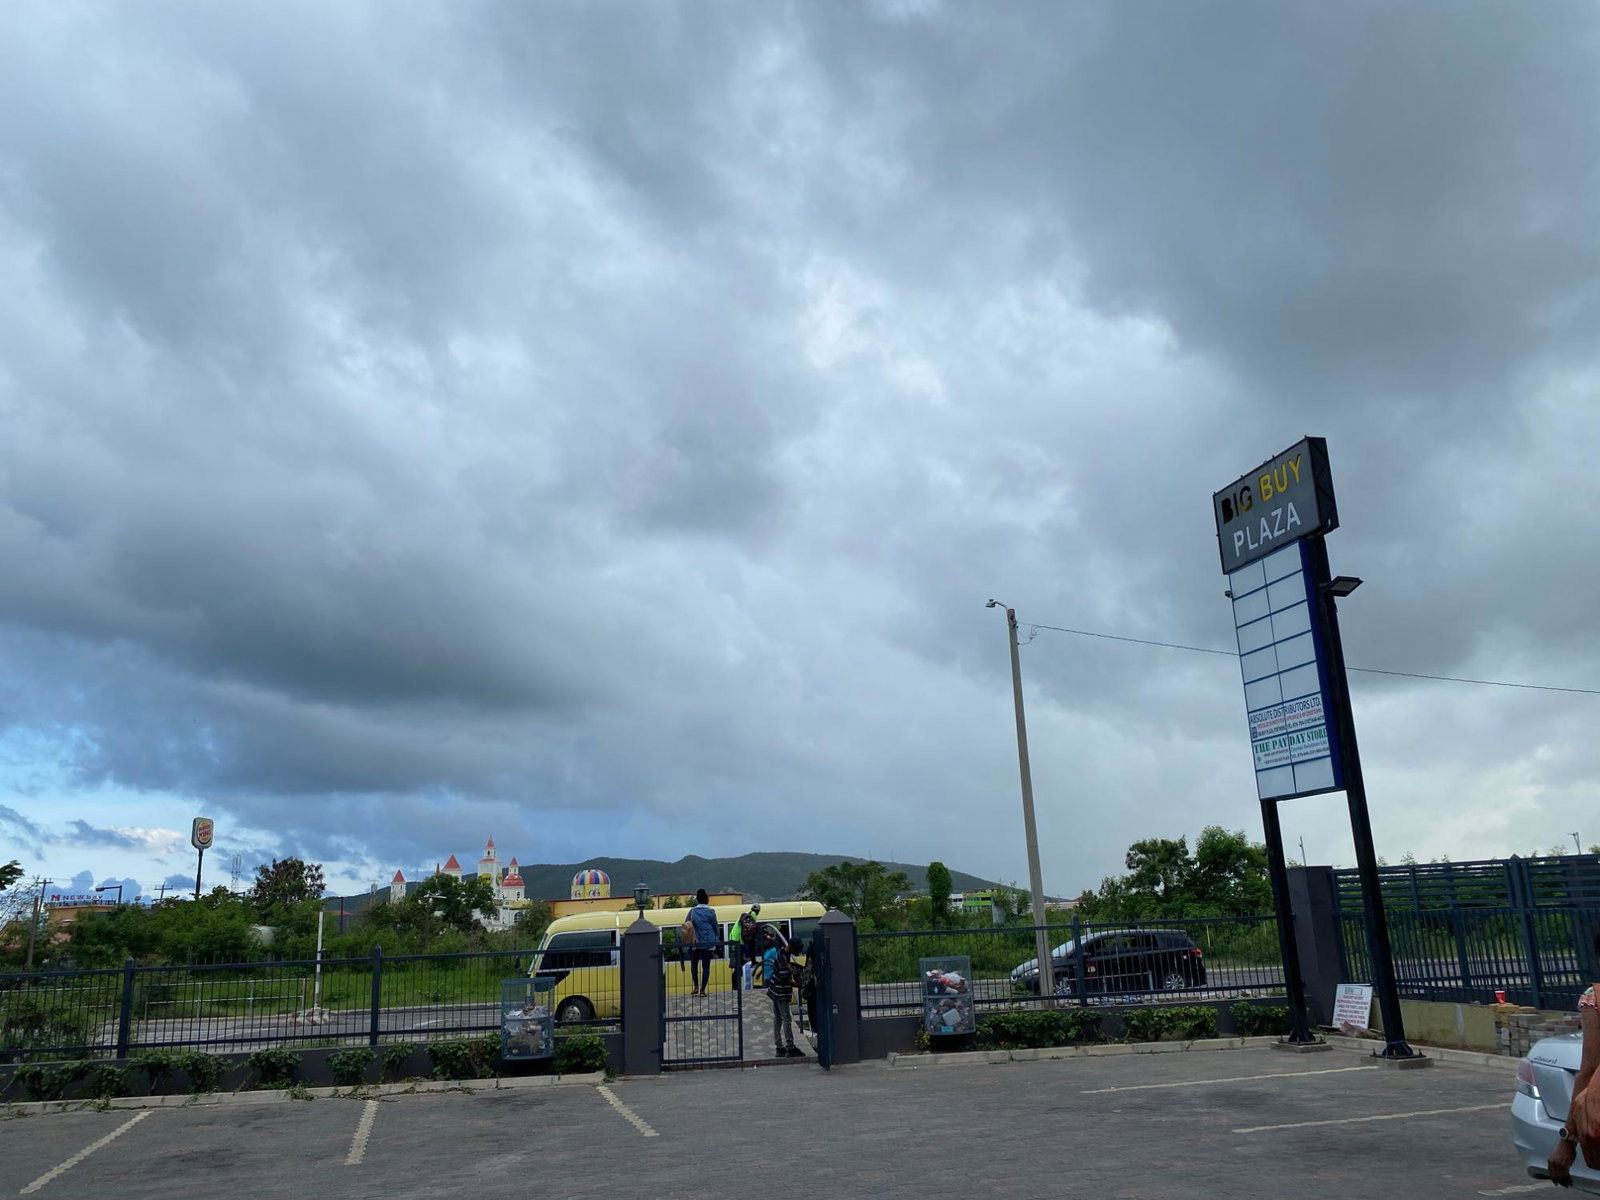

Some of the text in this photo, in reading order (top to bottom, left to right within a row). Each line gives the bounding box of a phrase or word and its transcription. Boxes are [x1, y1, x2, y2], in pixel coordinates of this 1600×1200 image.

[1221, 454, 1301, 524] BIG BUY
[1233, 501, 1301, 557] PLAZA
[1250, 710, 1273, 723] ABSOLUTE
[1273, 699, 1310, 718] DISTRIBUTORS
[1254, 741, 1270, 754] THE
[1306, 728, 1327, 741] STORE
[198, 829, 212, 840] KING
